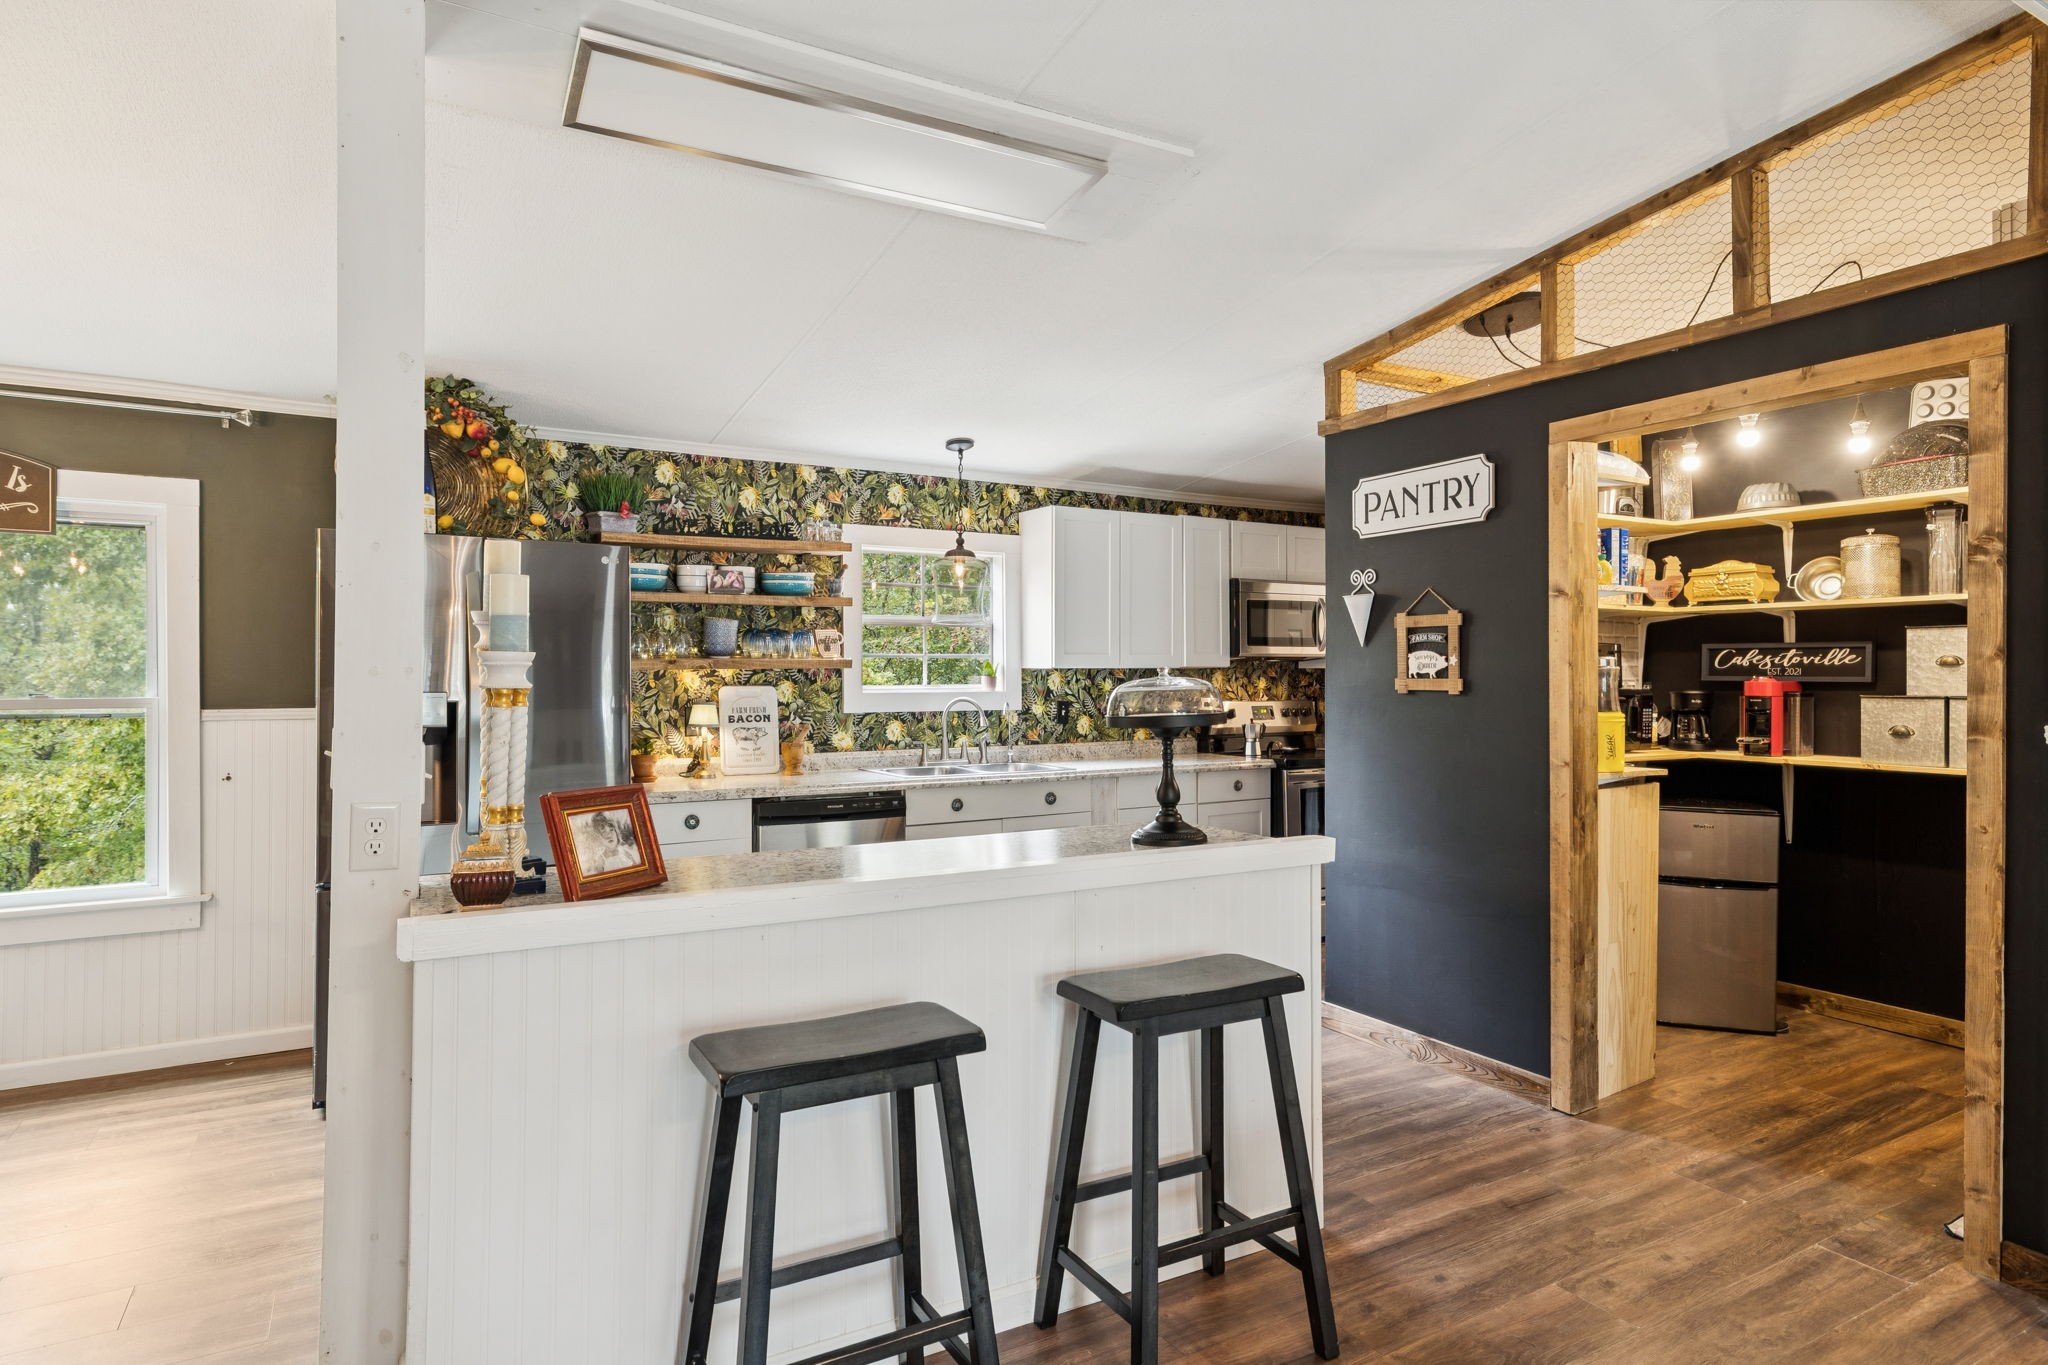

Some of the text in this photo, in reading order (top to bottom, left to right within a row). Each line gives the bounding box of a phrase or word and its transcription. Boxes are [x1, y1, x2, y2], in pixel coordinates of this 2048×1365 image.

[4, 464, 33, 493] Is
[1363, 472, 1480, 524] PANTRY
[1767, 667, 1802, 676] EST. 2021
[728, 714, 771, 724] BACON
[731, 706, 767, 714] FARM FRESH
[1605, 734, 1615, 761] SUGAR
